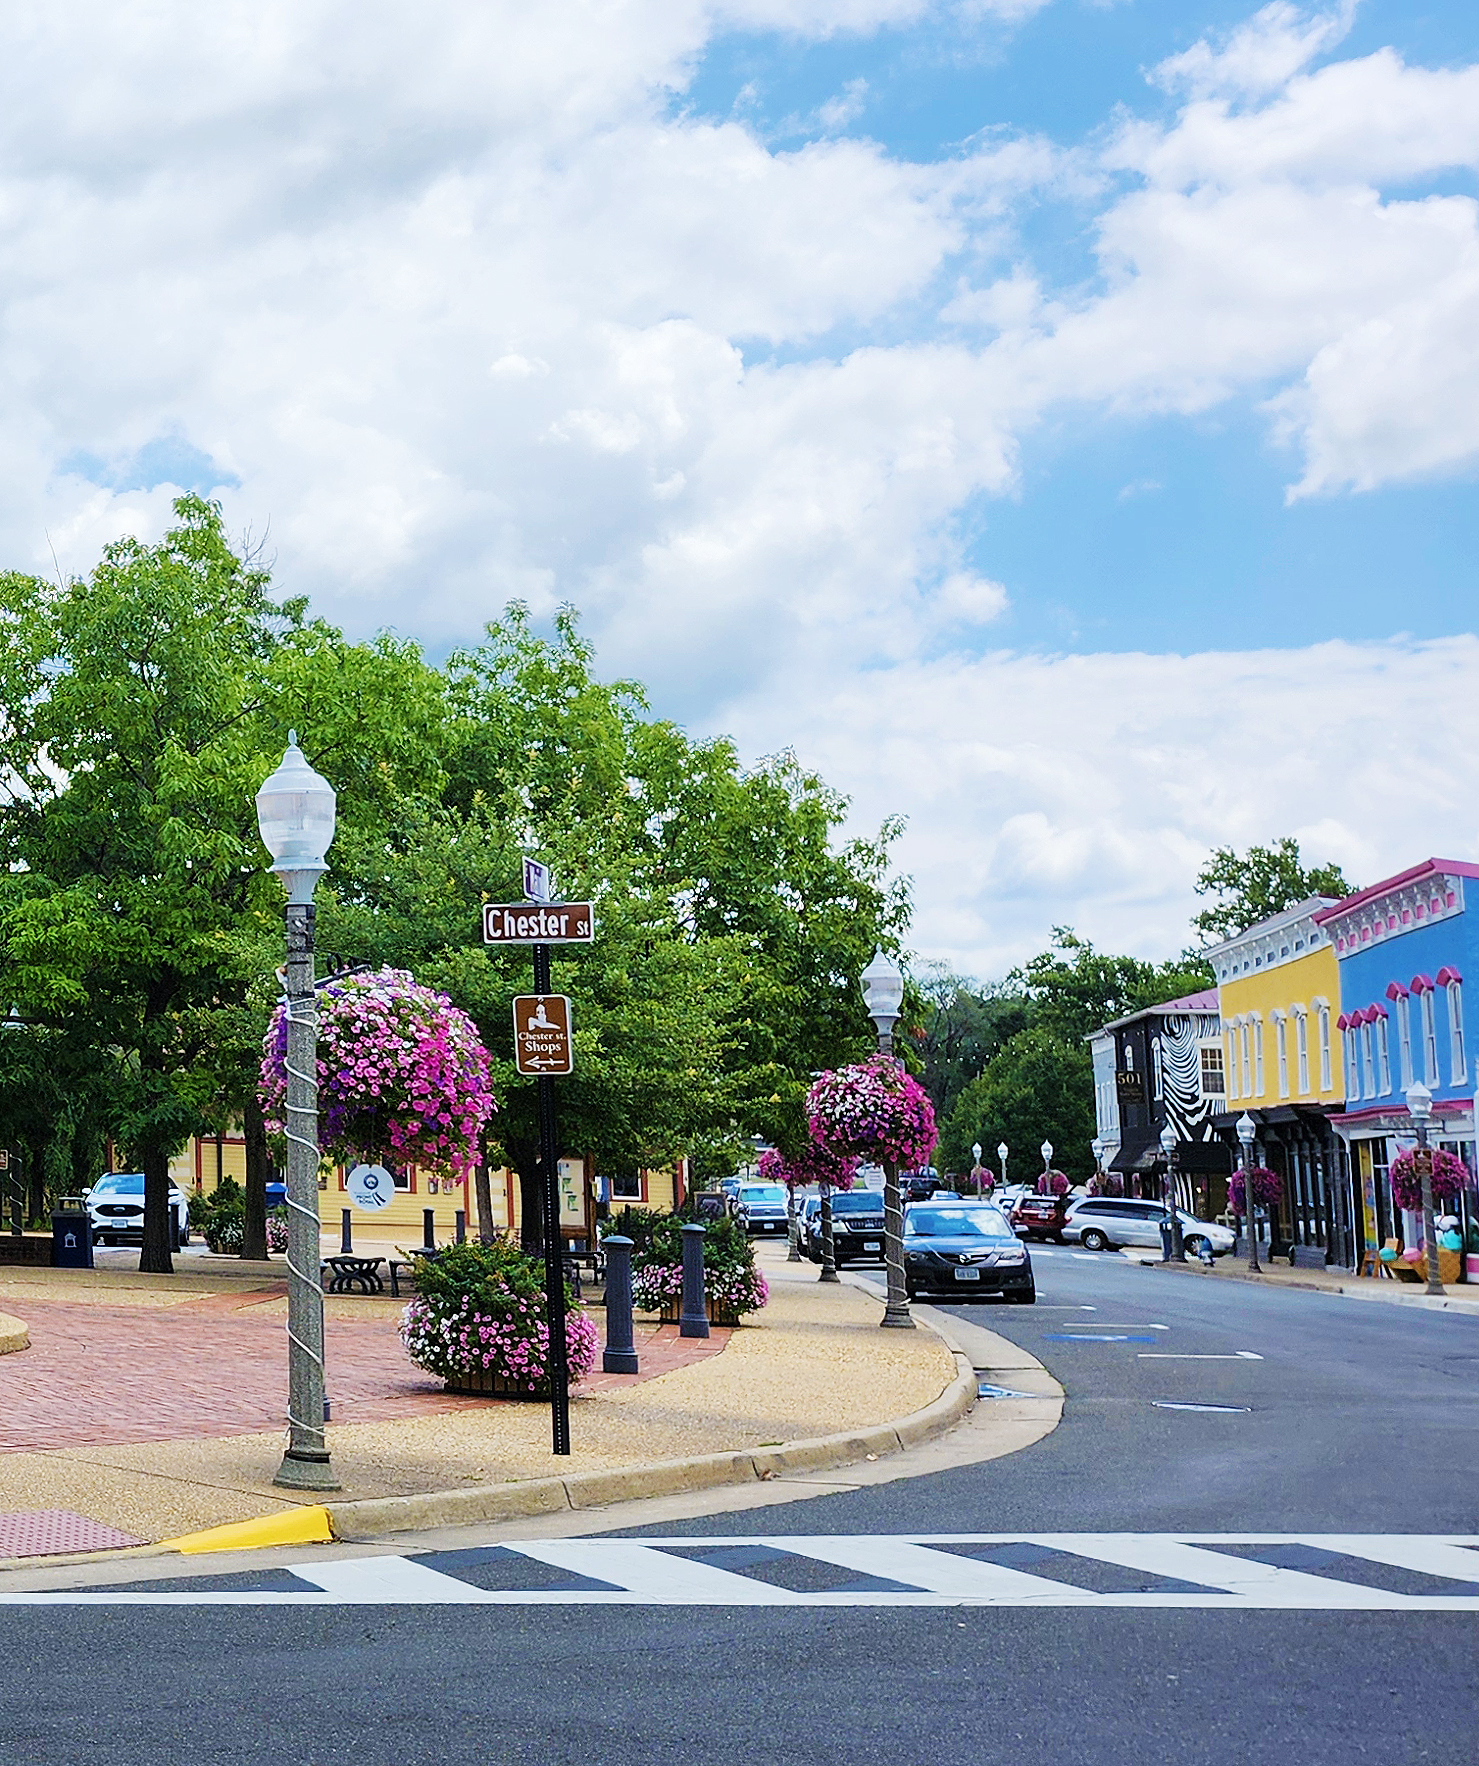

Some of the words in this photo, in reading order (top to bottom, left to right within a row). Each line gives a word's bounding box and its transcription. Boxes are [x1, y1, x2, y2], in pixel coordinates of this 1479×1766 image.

[488, 909, 569, 937] Chester
[576, 920, 589, 936] St
[518, 1031, 554, 1041] Chester
[524, 1040, 562, 1055] Shops
[1117, 1072, 1141, 1085] 501
